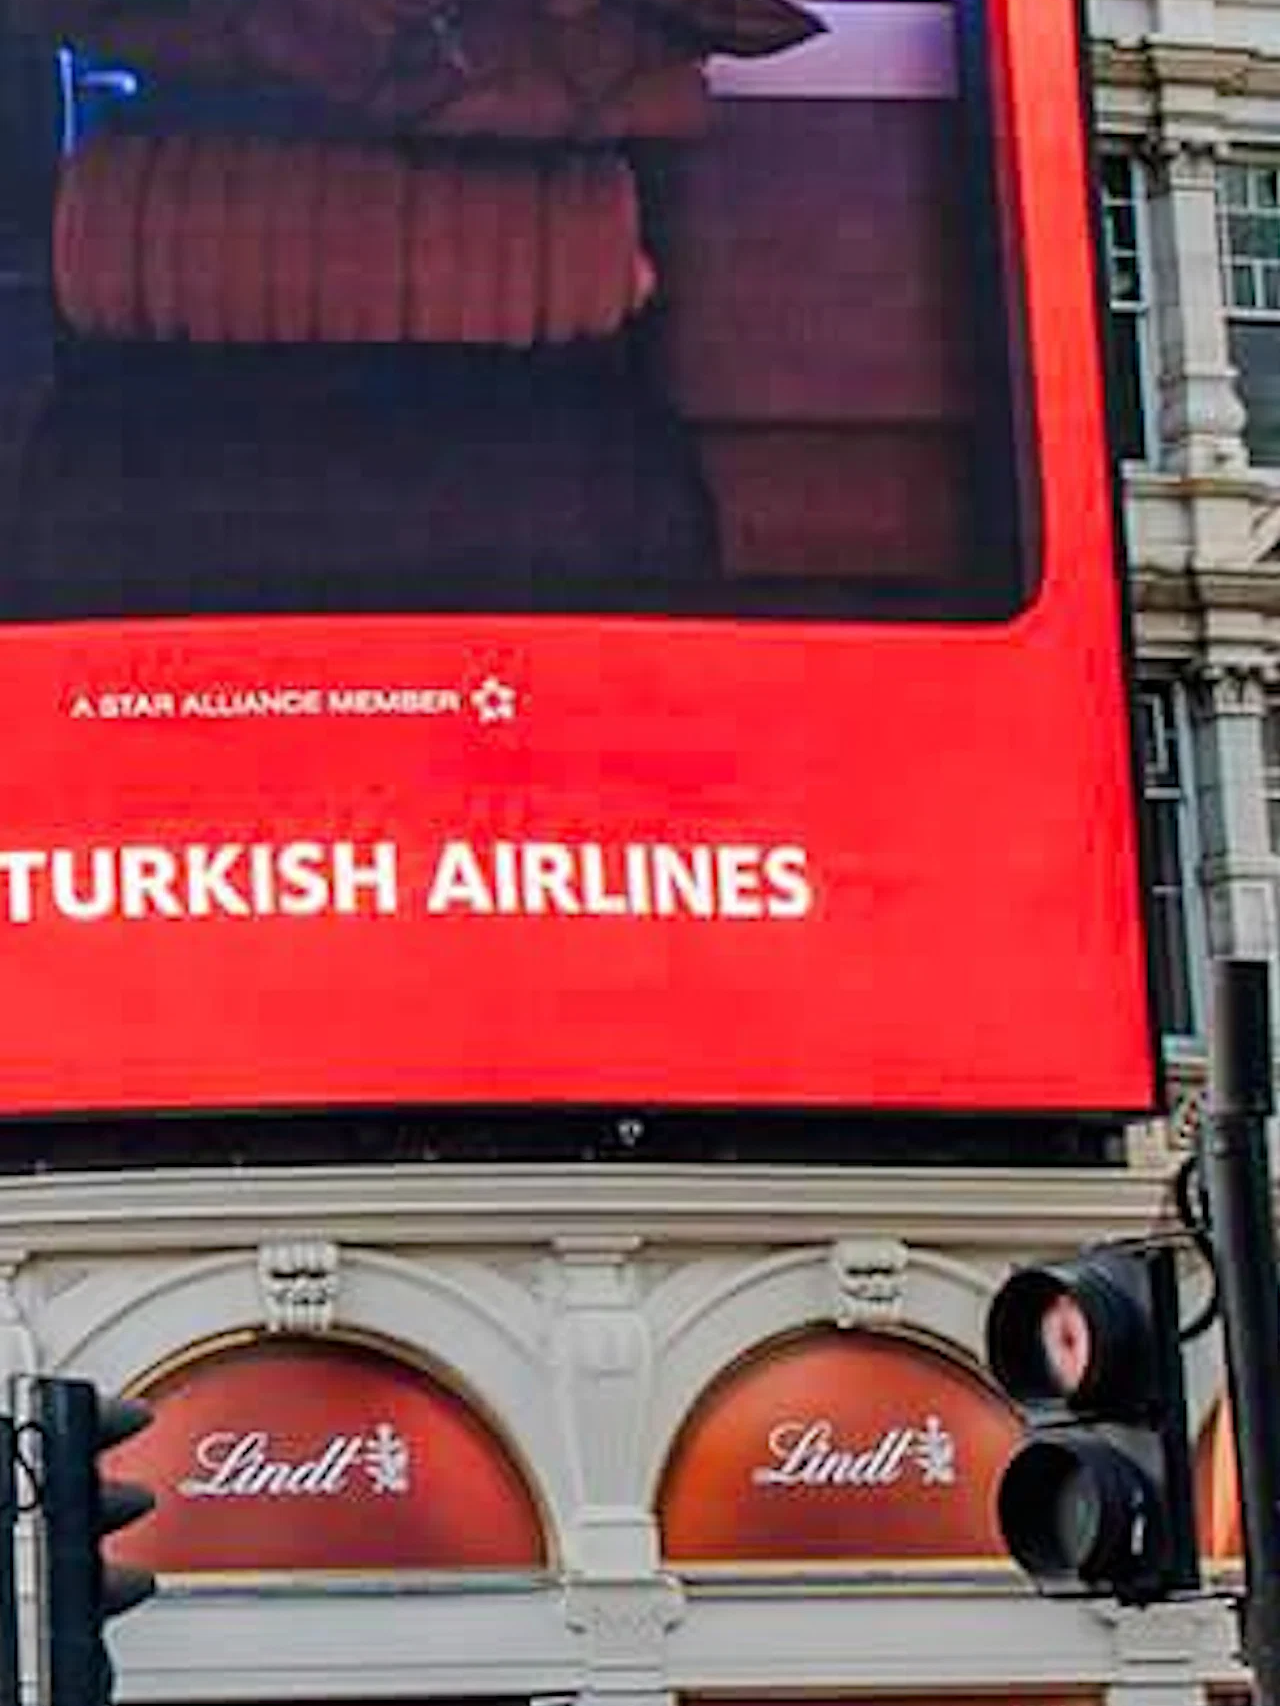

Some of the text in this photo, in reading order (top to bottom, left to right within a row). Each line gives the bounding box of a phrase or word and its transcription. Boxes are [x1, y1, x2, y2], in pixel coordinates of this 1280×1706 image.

[70, 690, 461, 718] A STAR ALLIANCE MEMBER
[427, 844, 810, 918] AIRLINES
[178, 1431, 365, 1497] Lindt
[755, 1419, 914, 1487] Lindt
